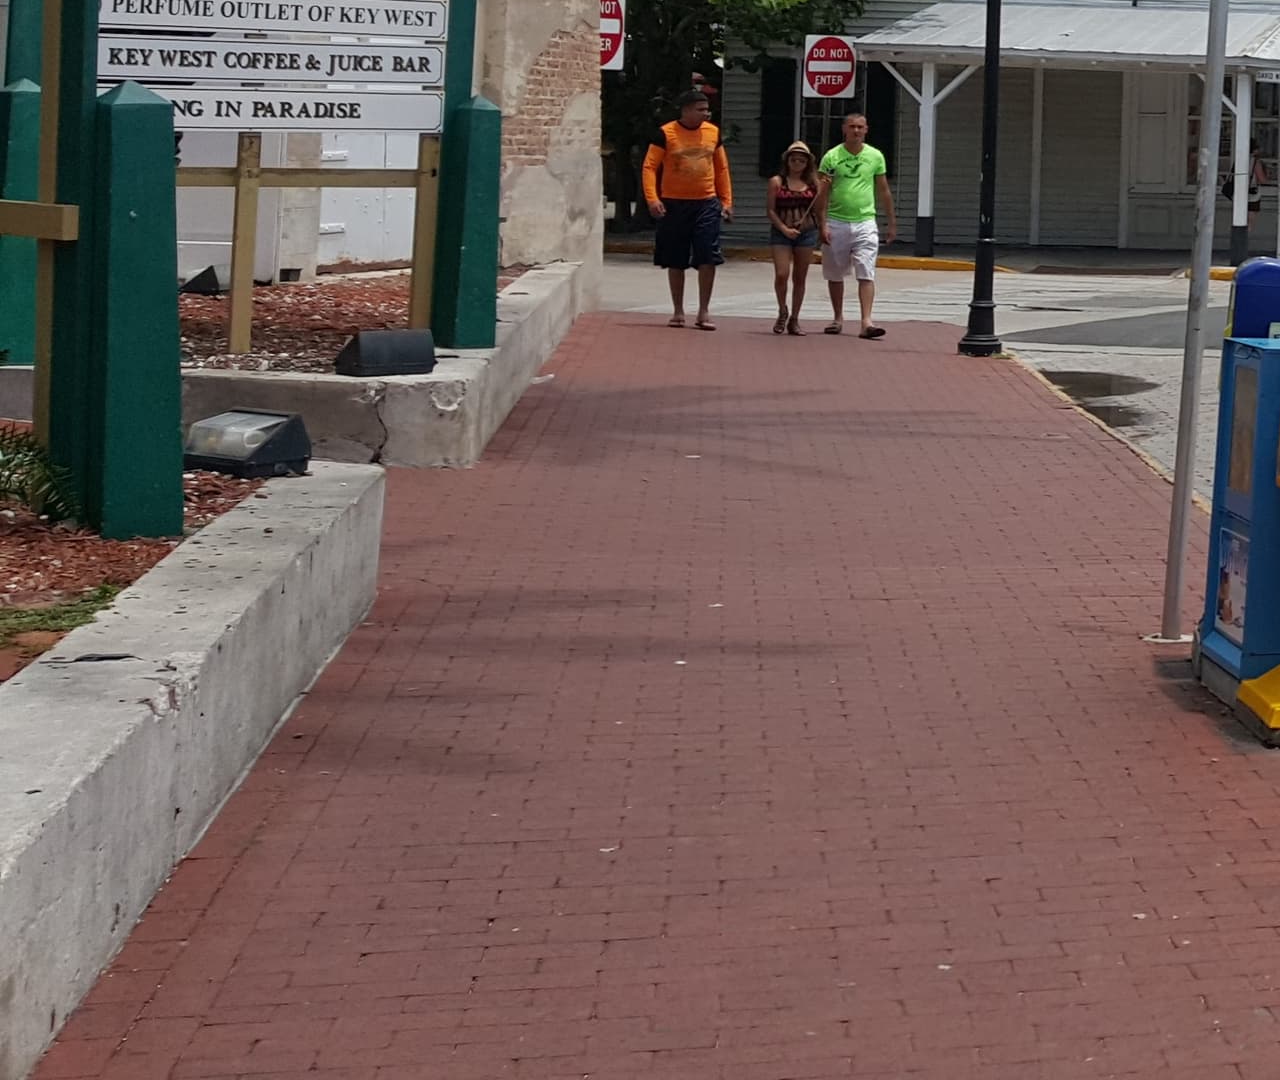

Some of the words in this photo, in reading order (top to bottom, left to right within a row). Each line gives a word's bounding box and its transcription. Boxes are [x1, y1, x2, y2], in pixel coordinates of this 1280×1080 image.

[220, 0, 303, 21] OUTLET
[308, 5, 335, 22] OF
[340, 7, 380, 24] KEY
[384, 9, 437, 27] WEST
[108, 47, 153, 66] KEY
[158, 49, 217, 68] WEST
[223, 51, 300, 70] COFFEE
[305, 54, 321, 71] &
[325, 54, 383, 77] JUICE
[392, 56, 431, 73] BAR
[813, 48, 825, 58] DO
[830, 48, 848, 58] NOT
[815, 75, 843, 85] ENTER
[215, 101, 242, 117] IN
[252, 101, 361, 119] PARADISE
